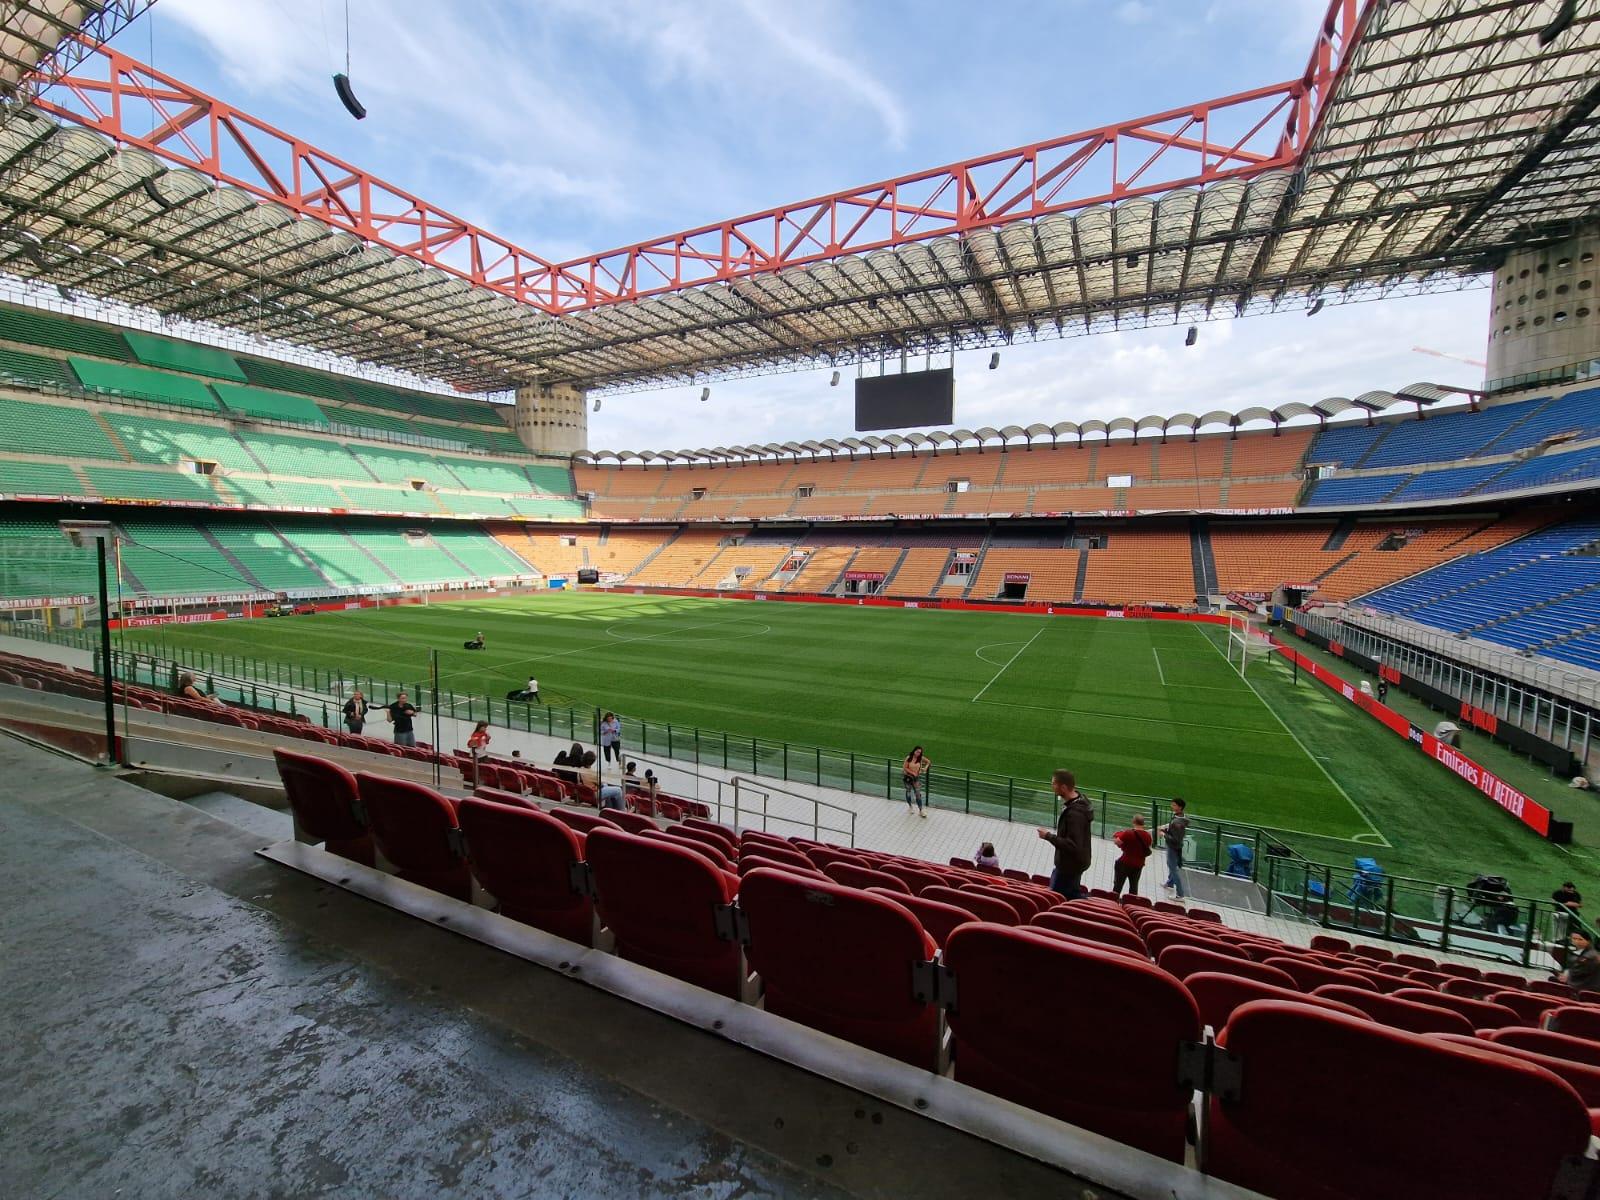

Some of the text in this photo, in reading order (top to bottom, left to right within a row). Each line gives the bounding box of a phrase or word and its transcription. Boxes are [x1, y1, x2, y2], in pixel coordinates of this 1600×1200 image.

[134, 598, 165, 608] MILAN
[248, 592, 276, 602] CALCIO
[1435, 742, 1525, 818] Emirates FLY BETTER
